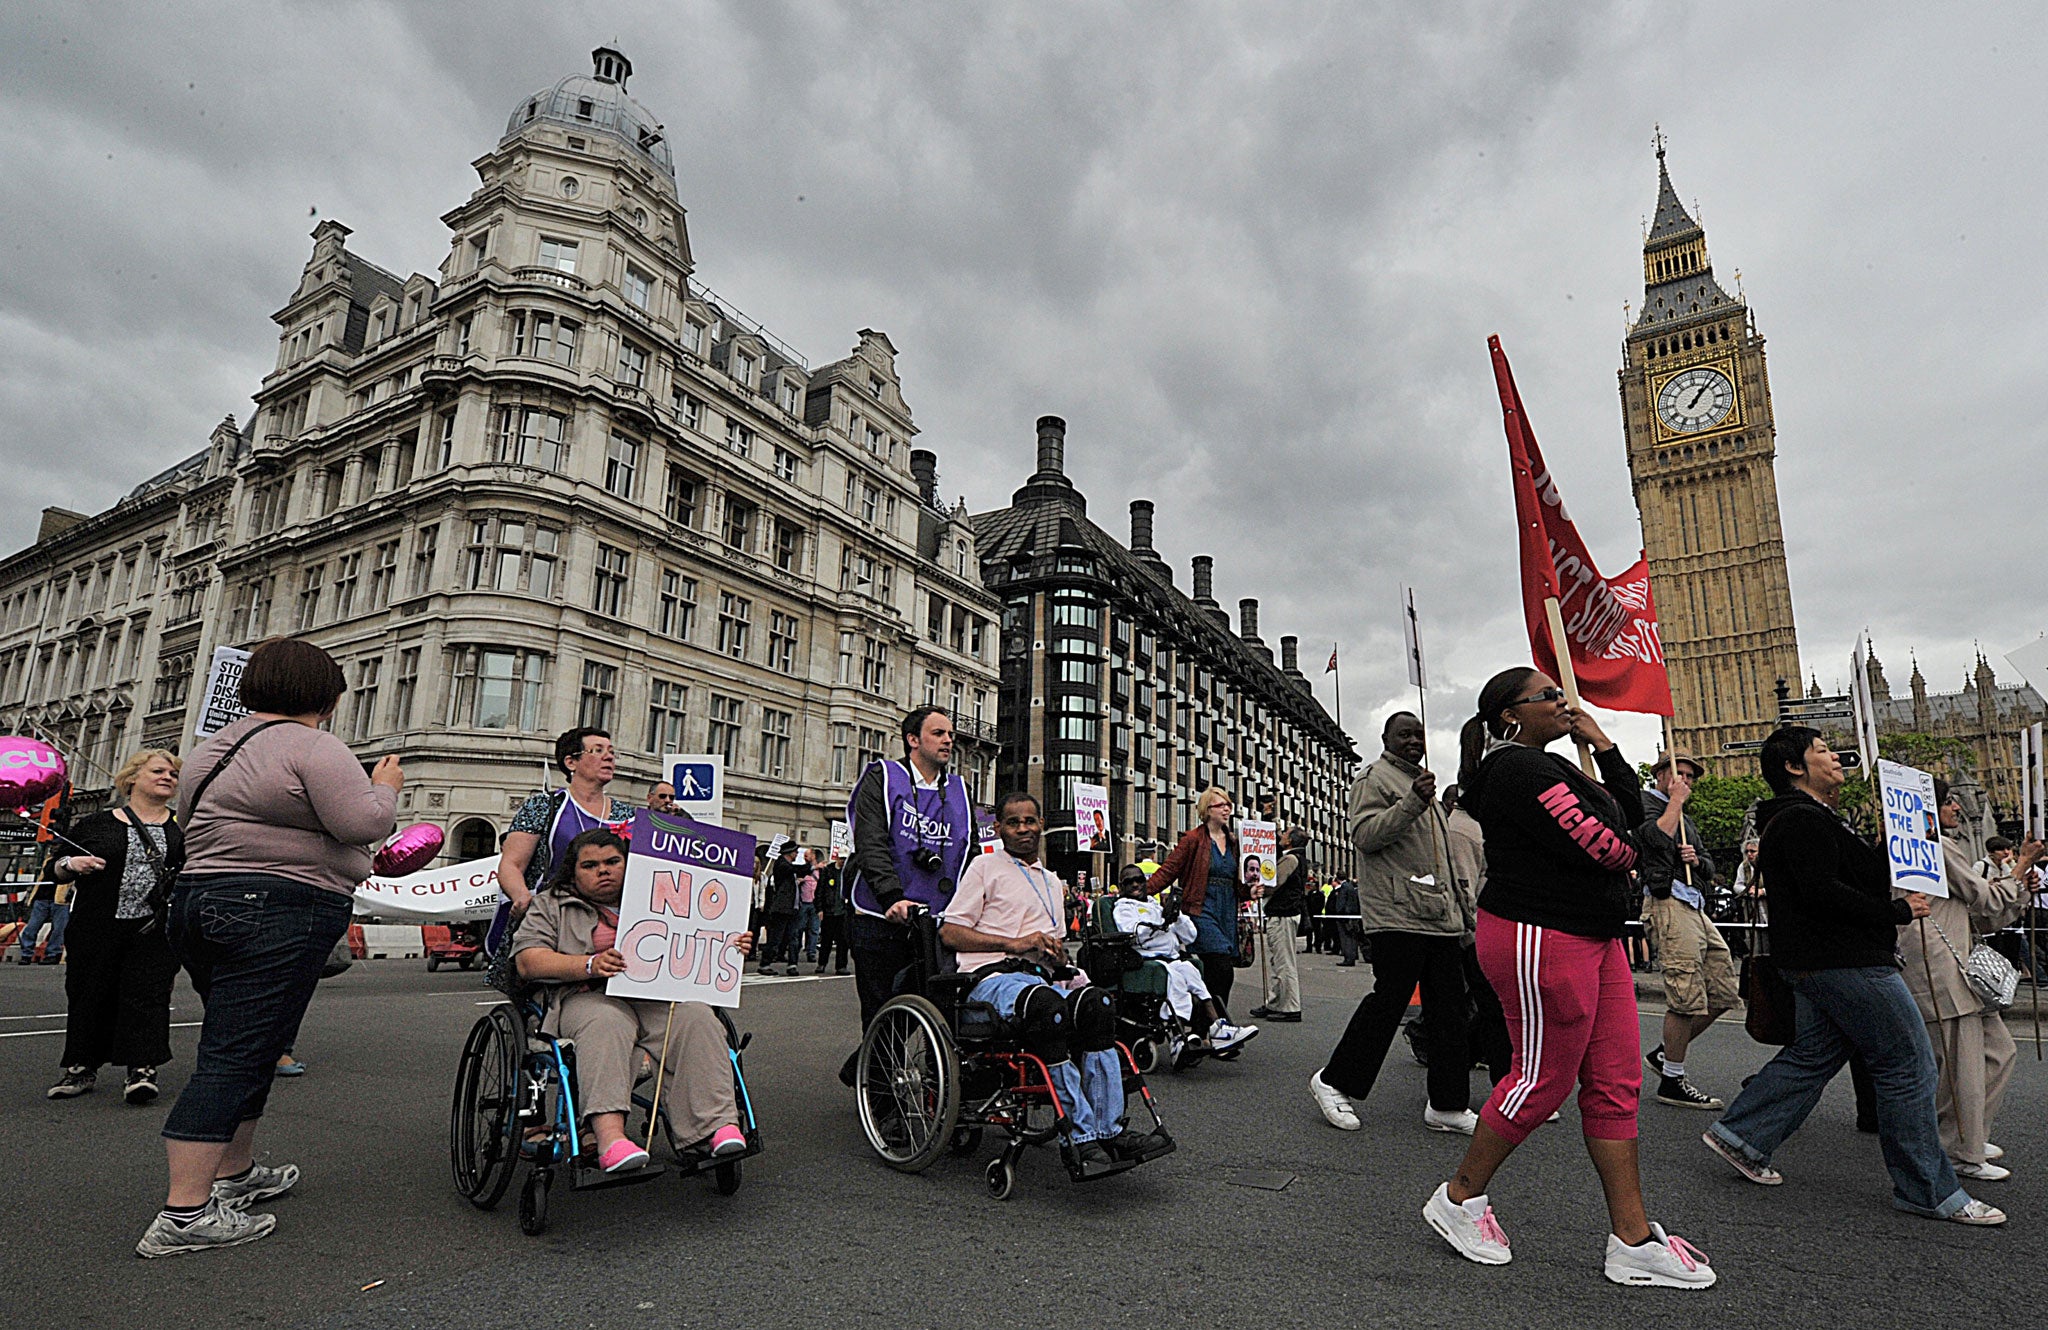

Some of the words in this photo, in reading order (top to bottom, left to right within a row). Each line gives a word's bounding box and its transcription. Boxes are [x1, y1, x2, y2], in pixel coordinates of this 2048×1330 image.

[1886, 786, 1923, 814] STOP
[1077, 810, 1091, 821] TOO
[1889, 812, 1913, 833] THE
[1078, 824, 1096, 836] DAVE
[651, 831, 737, 866] UNISON
[1889, 835, 1938, 871] CUTS!
[411, 879, 461, 896] CUT
[650, 869, 728, 921] NO
[620, 919, 744, 993] CUTS
